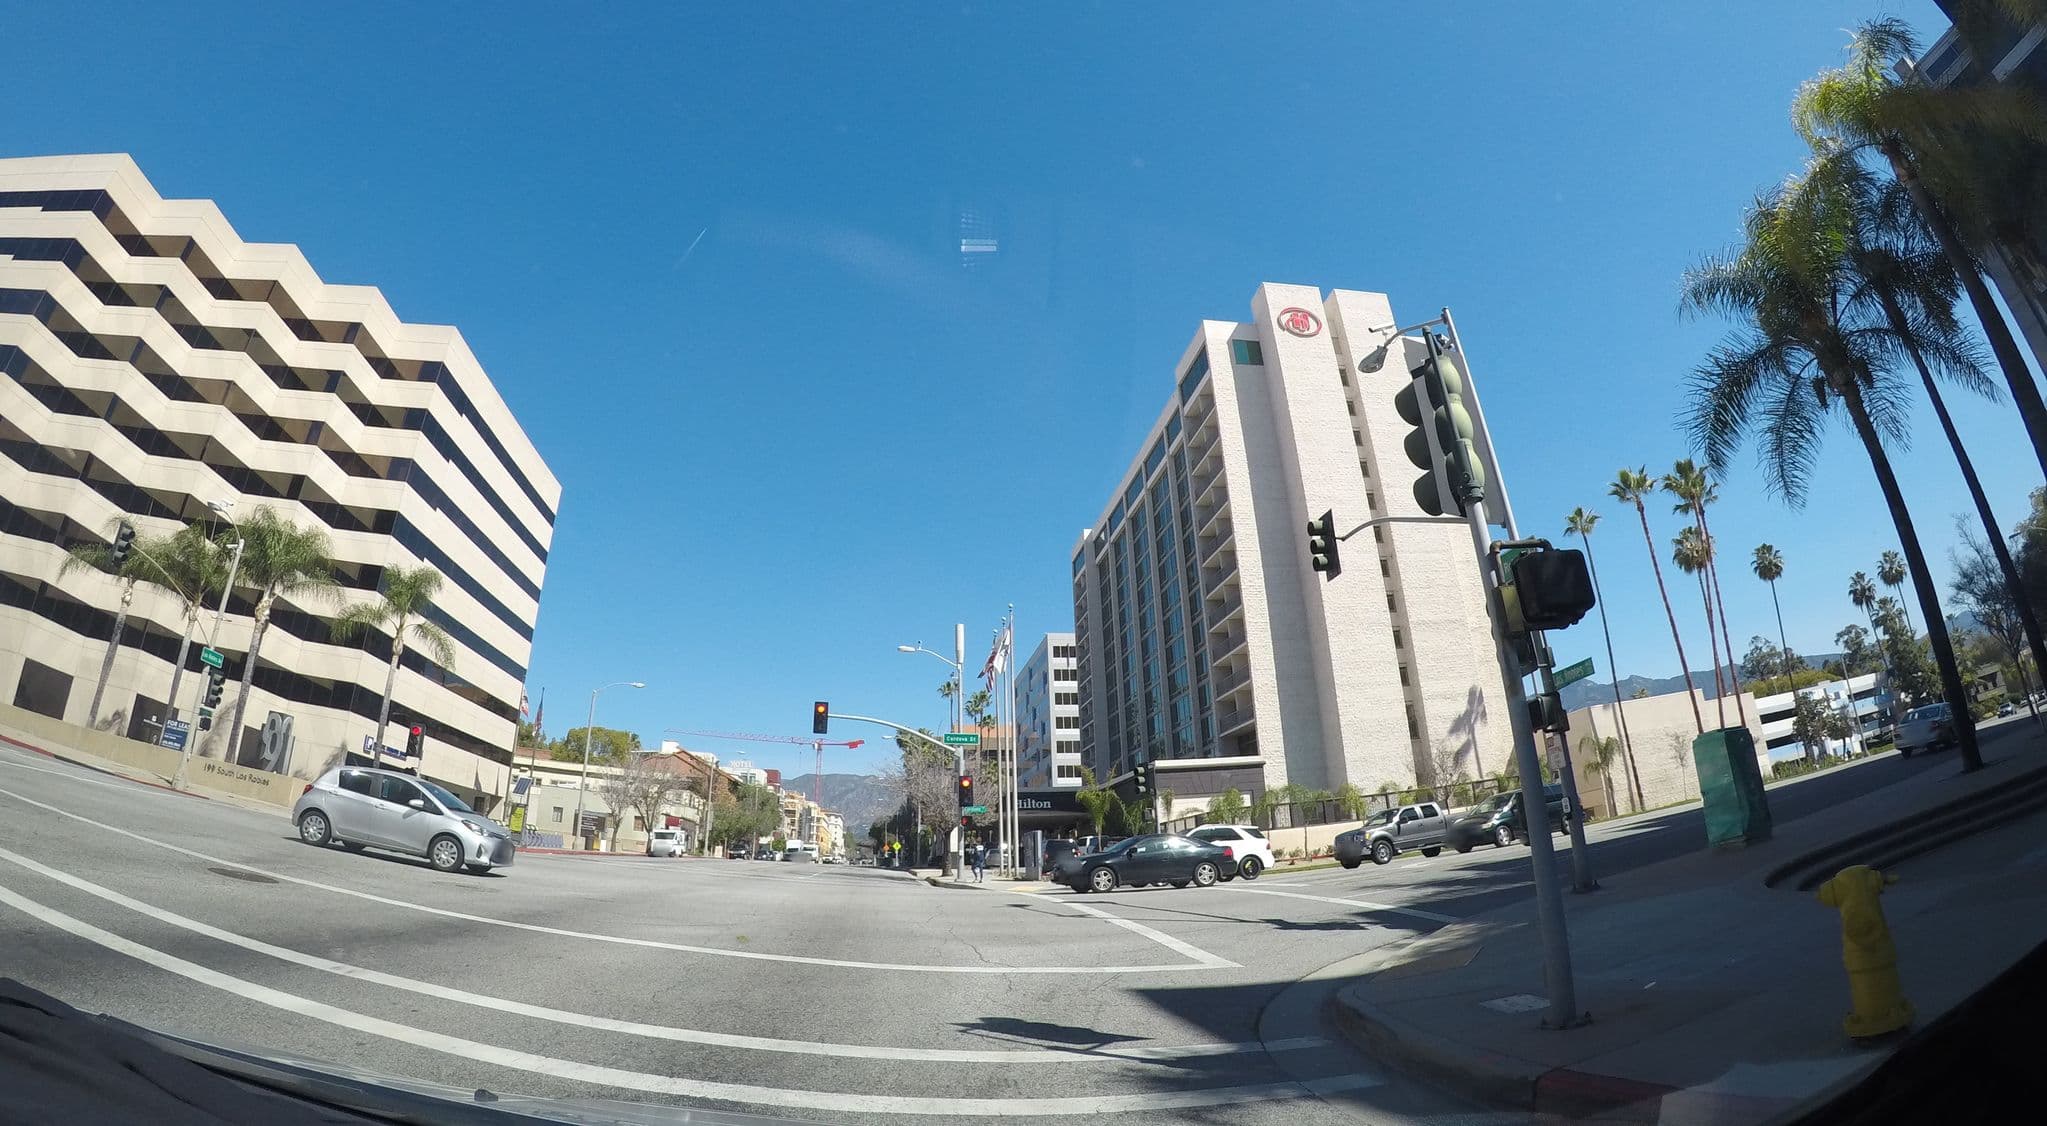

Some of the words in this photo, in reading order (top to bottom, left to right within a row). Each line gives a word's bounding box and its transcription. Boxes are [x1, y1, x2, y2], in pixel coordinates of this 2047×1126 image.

[167, 719, 178, 727] FOR
[204, 763, 216, 773] 199
[236, 771, 247, 781] Los
